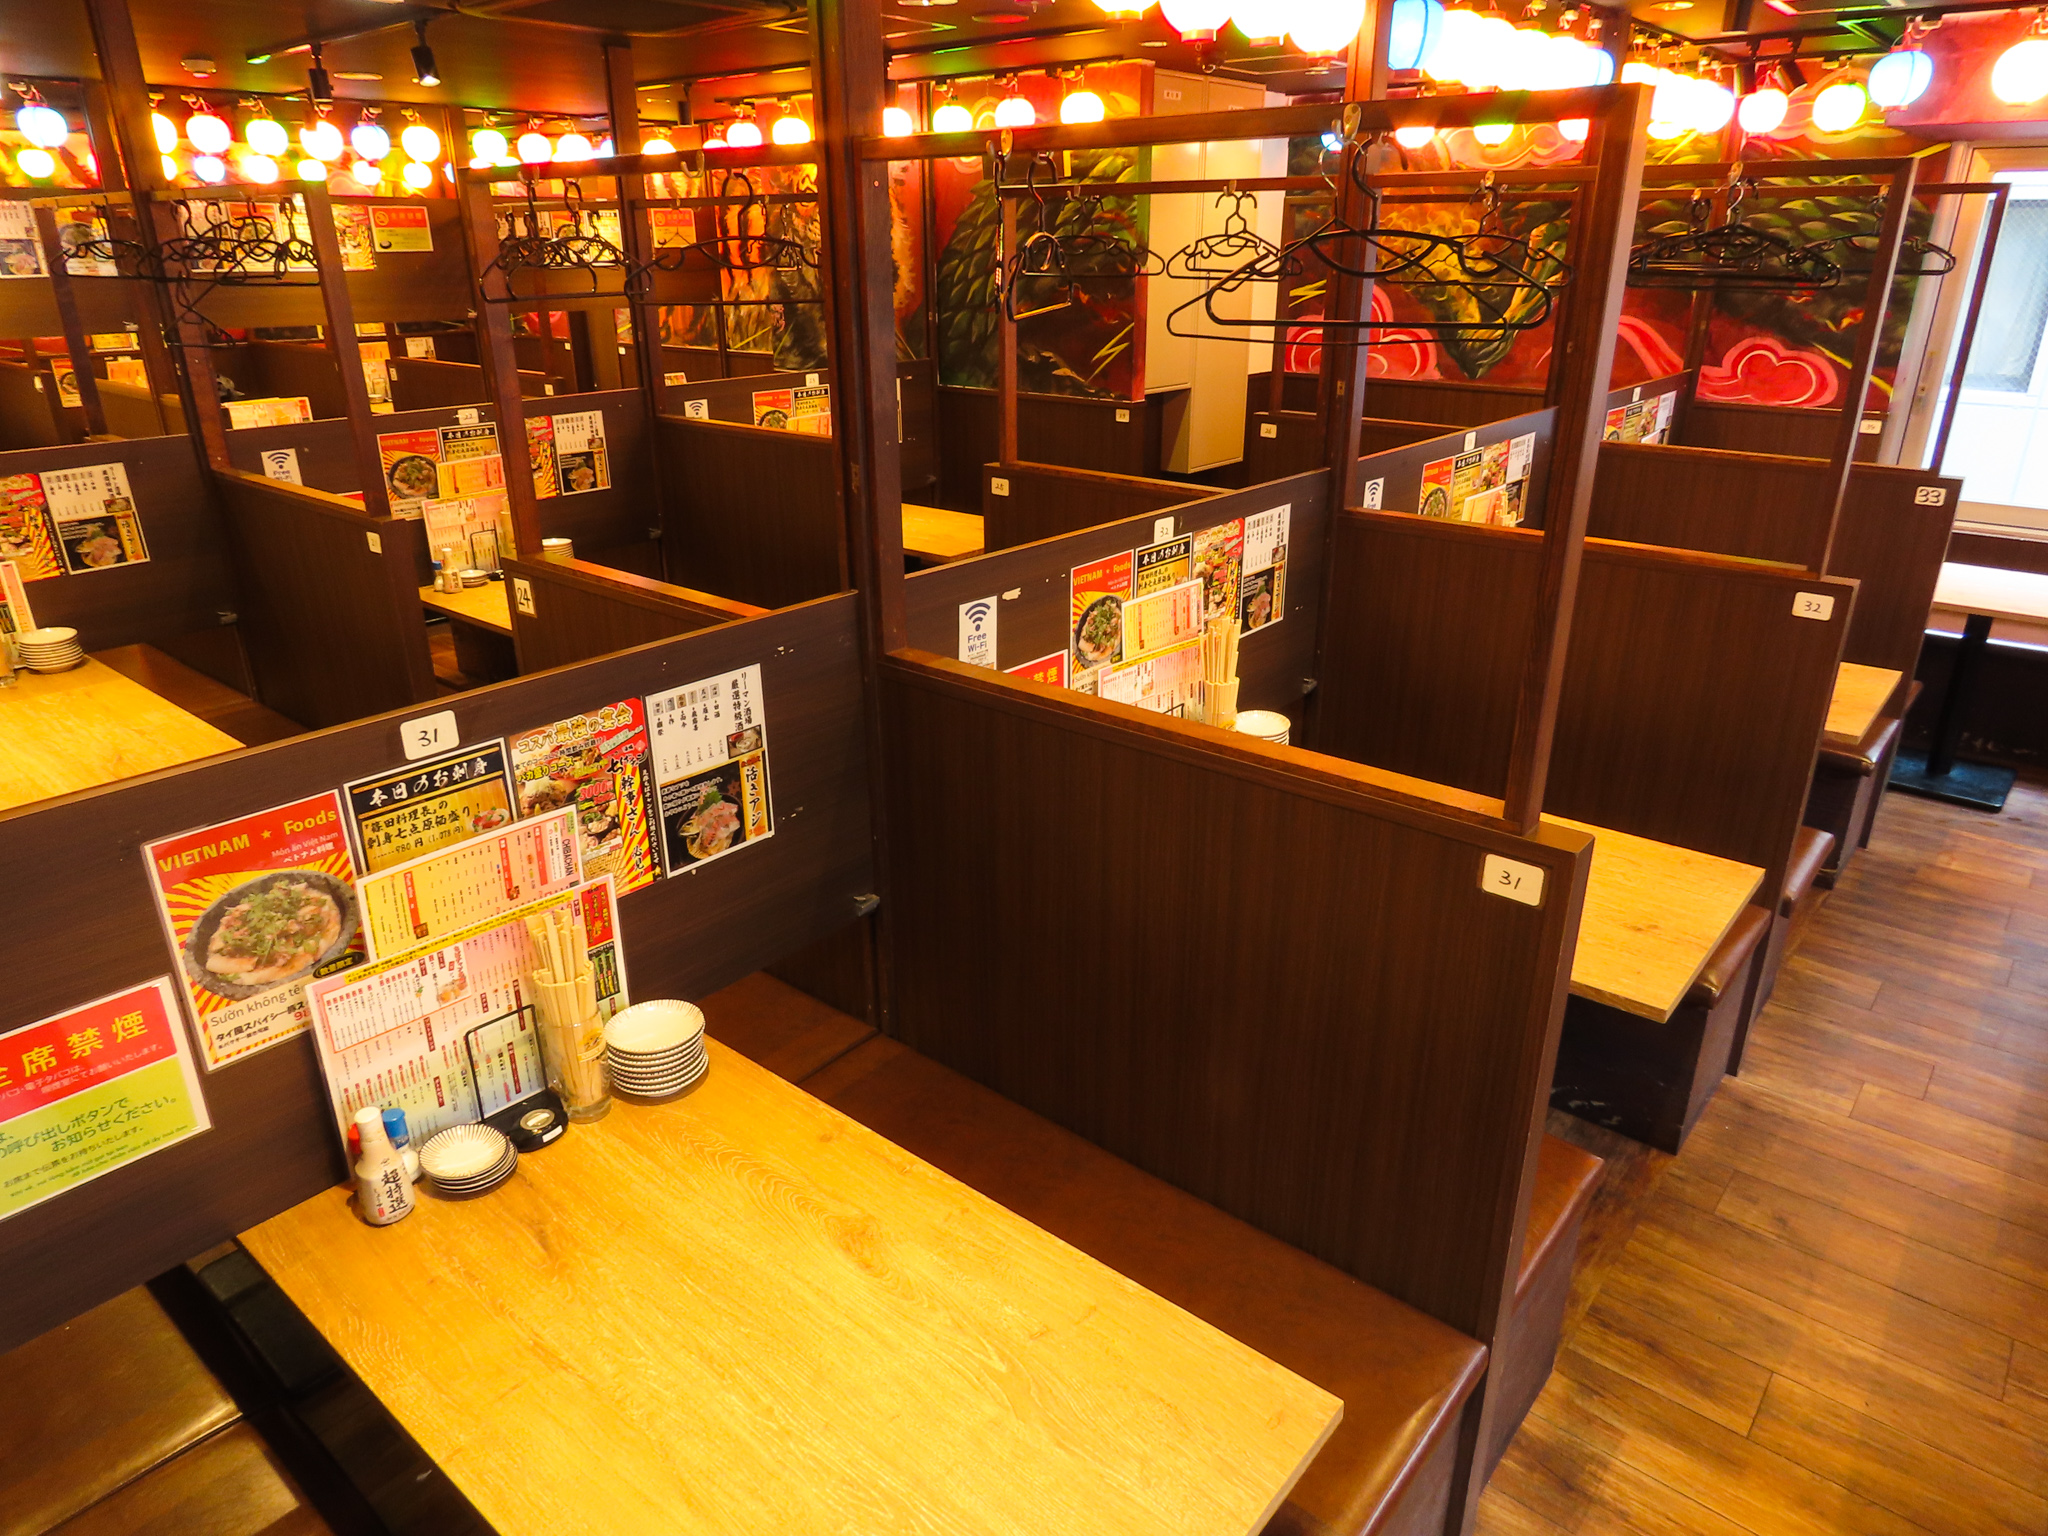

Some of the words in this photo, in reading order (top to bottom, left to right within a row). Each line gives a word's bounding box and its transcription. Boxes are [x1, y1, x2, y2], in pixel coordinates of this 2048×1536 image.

[1917, 488, 1942, 504] 33
[1160, 526, 1170, 538] 32
[1073, 569, 1103, 587] VIETNAM
[1113, 561, 1131, 573] Foods
[516, 587, 531, 609] 24
[1803, 600, 1823, 614] 32
[967, 632, 987, 644] Free
[967, 641, 987, 653] Wi-Fi
[741, 671, 753, 725] リーマン酒場
[417, 728, 438, 747] 31
[516, 703, 633, 754] コスパ最強の宴会
[369, 757, 488, 808] 本日のお刺身
[620, 774, 642, 839] 幹事さん
[745, 766, 761, 828] 活きアジ
[157, 833, 251, 873] VIETNAM
[283, 809, 337, 835] Foods
[1498, 870, 1522, 890] 31
[210, 1008, 245, 1027] Sườn
[246, 991, 287, 1013] không
[51, 1096, 178, 1153] お知らせください。
